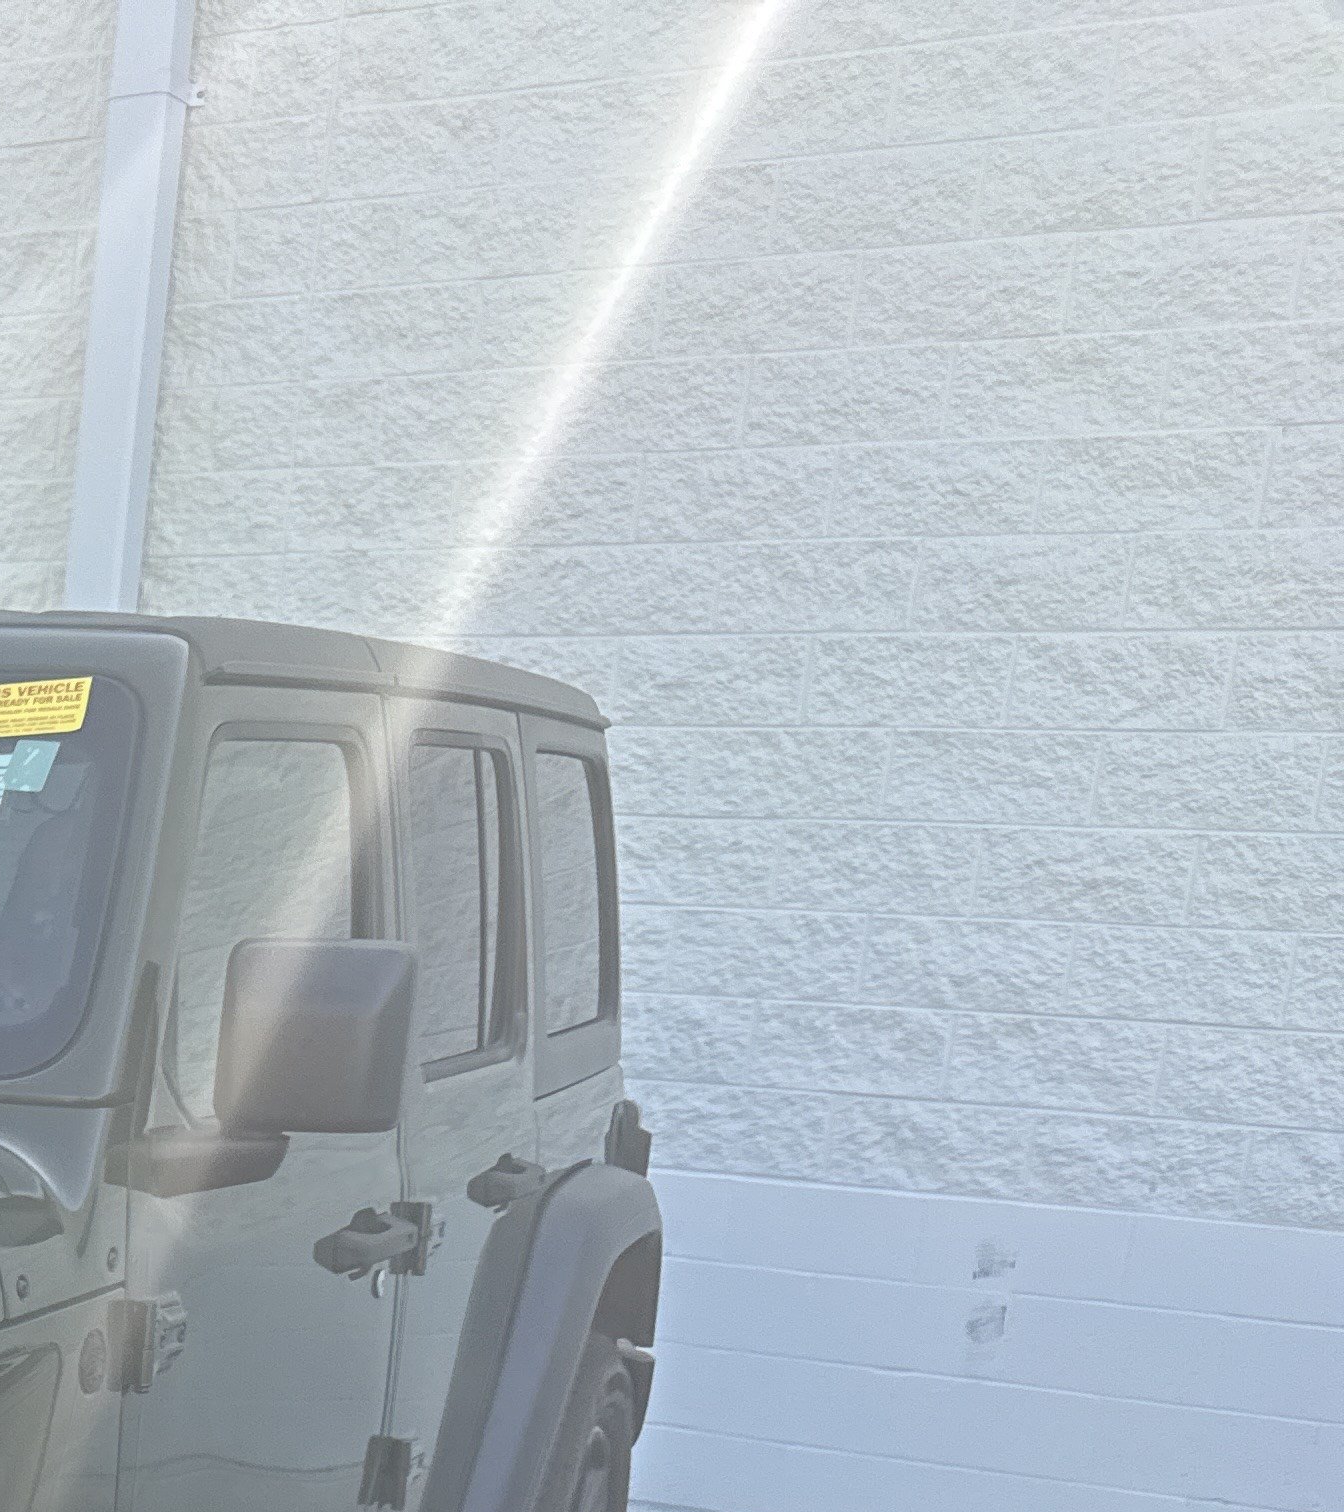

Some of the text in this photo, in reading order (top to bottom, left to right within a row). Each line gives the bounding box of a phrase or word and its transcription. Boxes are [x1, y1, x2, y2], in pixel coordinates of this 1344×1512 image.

[17, 681, 86, 697] VEHICLE
[33, 696, 54, 707] FOR
[55, 693, 83, 703] SALE
